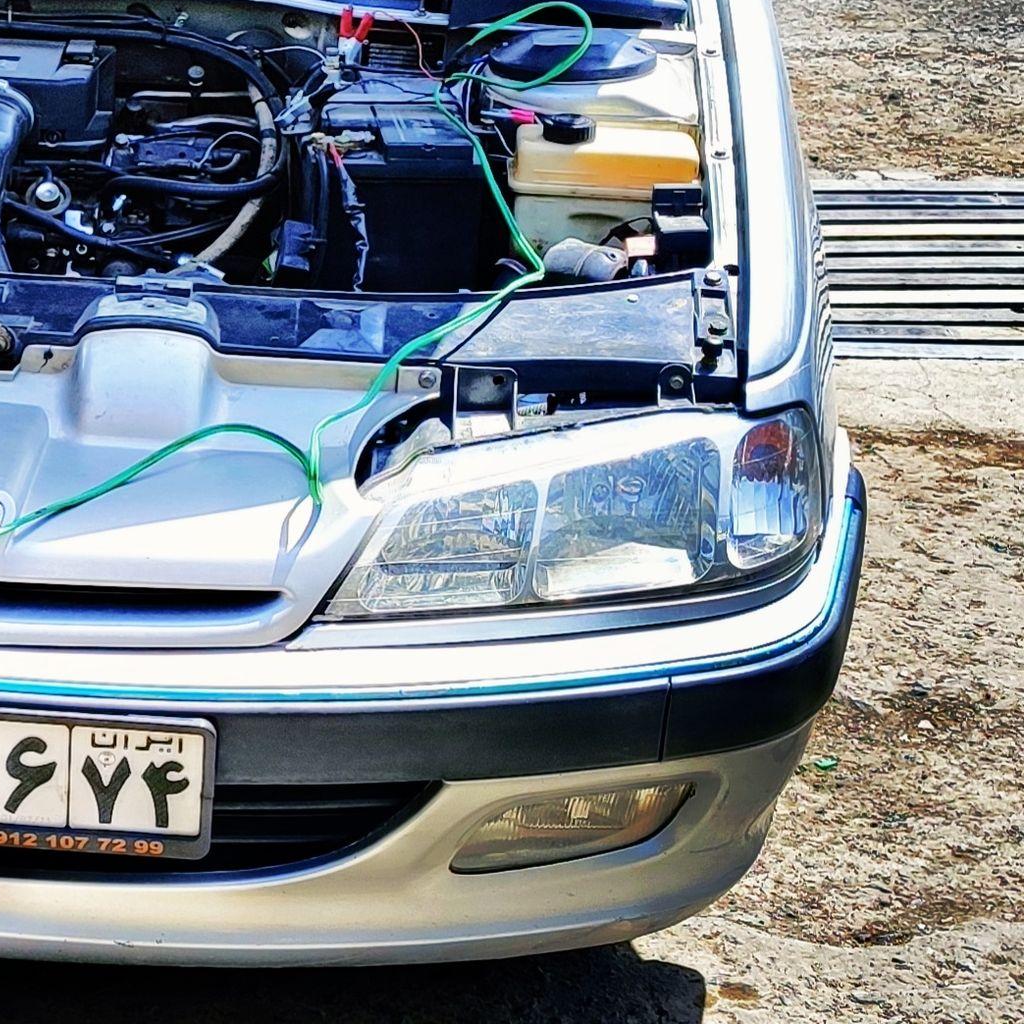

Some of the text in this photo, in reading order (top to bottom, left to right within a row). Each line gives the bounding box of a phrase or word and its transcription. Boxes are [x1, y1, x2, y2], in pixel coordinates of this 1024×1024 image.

[91, 732, 184, 755] ایران
[45, 834, 90, 850] 107
[97, 837, 126, 853] 72
[133, 839, 164, 856] 99
